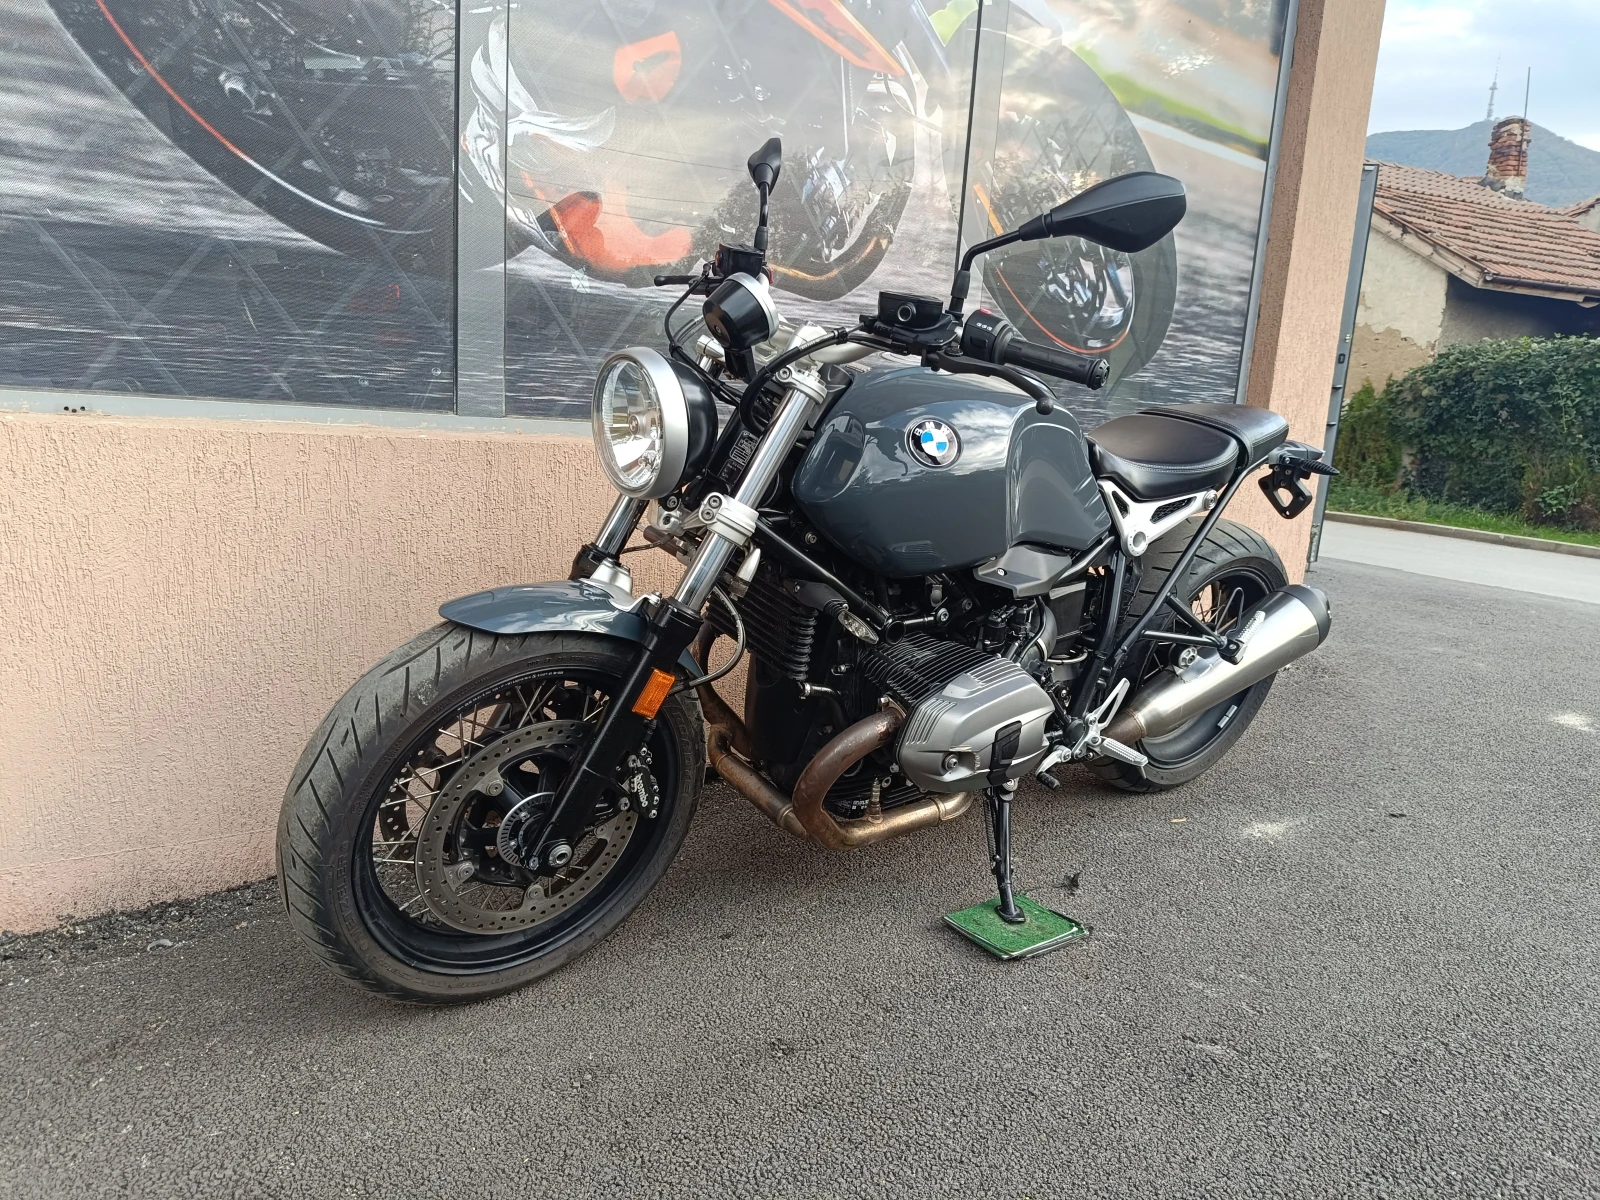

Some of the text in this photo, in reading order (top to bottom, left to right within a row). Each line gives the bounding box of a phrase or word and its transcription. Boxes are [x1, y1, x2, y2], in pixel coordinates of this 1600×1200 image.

[915, 421, 951, 437] BMW
[636, 773, 649, 808] brembo
[336, 853, 365, 945] METZELER
